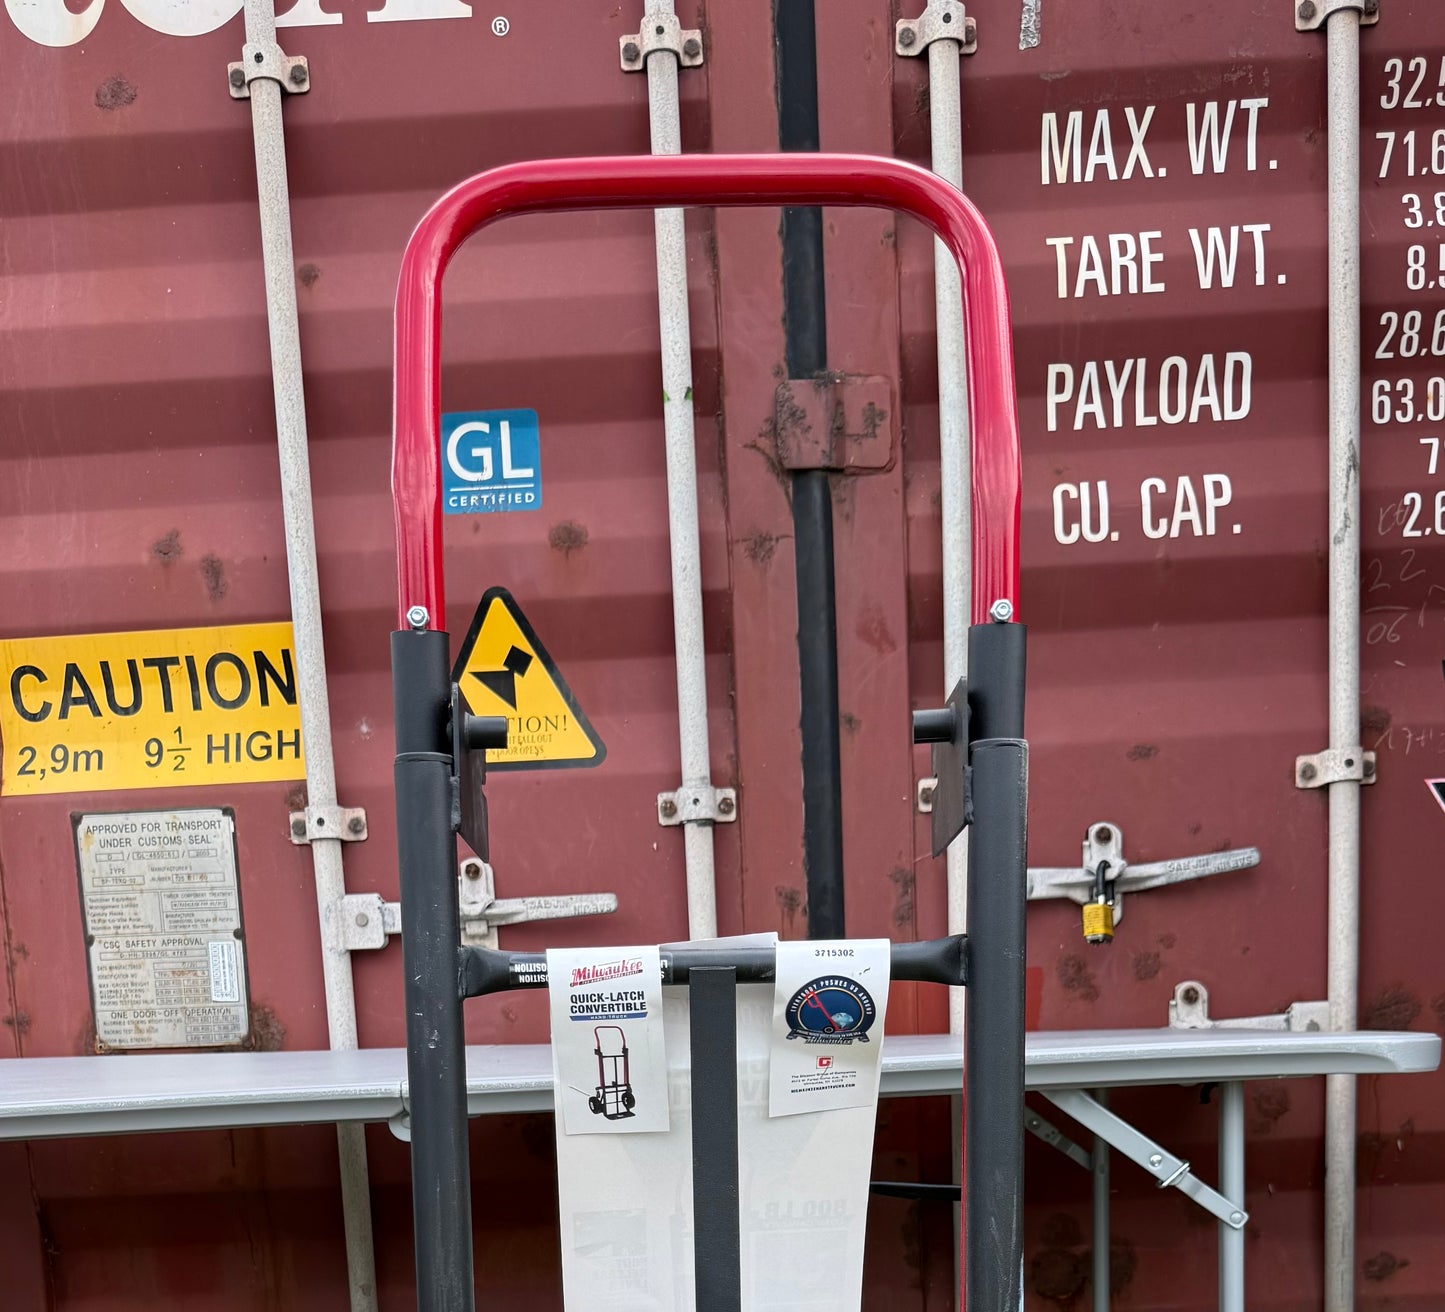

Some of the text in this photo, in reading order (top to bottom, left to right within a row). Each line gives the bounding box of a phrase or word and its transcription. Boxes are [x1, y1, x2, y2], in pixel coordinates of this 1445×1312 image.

[1041, 97, 1278, 185] MAX. WT.
[1045, 224, 1287, 299] TARE WT.
[1046, 351, 1253, 432] PAYLOAD
[446, 420, 534, 482] GL
[448, 492, 535, 507] CERTIFIED
[1053, 473, 1242, 545] CU. CAP.
[10, 648, 297, 722] CAUTION
[17, 744, 103, 780] 2,9m
[206, 729, 300, 764] HIGH
[86, 820, 222, 835] APPROVED FOR TRANSPORT
[100, 835, 211, 848] UNDER CUSTOMS SEAL
[103, 937, 205, 950] CSC SAFETY APPROVAL
[514, 963, 546, 972] OSITION
[570, 960, 643, 986] Milwaukee
[518, 974, 549, 983] OSITION
[570, 990, 645, 1004] QUICK-LATCH
[111, 1011, 128, 1020] ONE
[185, 1007, 231, 1018] OPERATION
[570, 1002, 647, 1014] CONVERTIBLE
